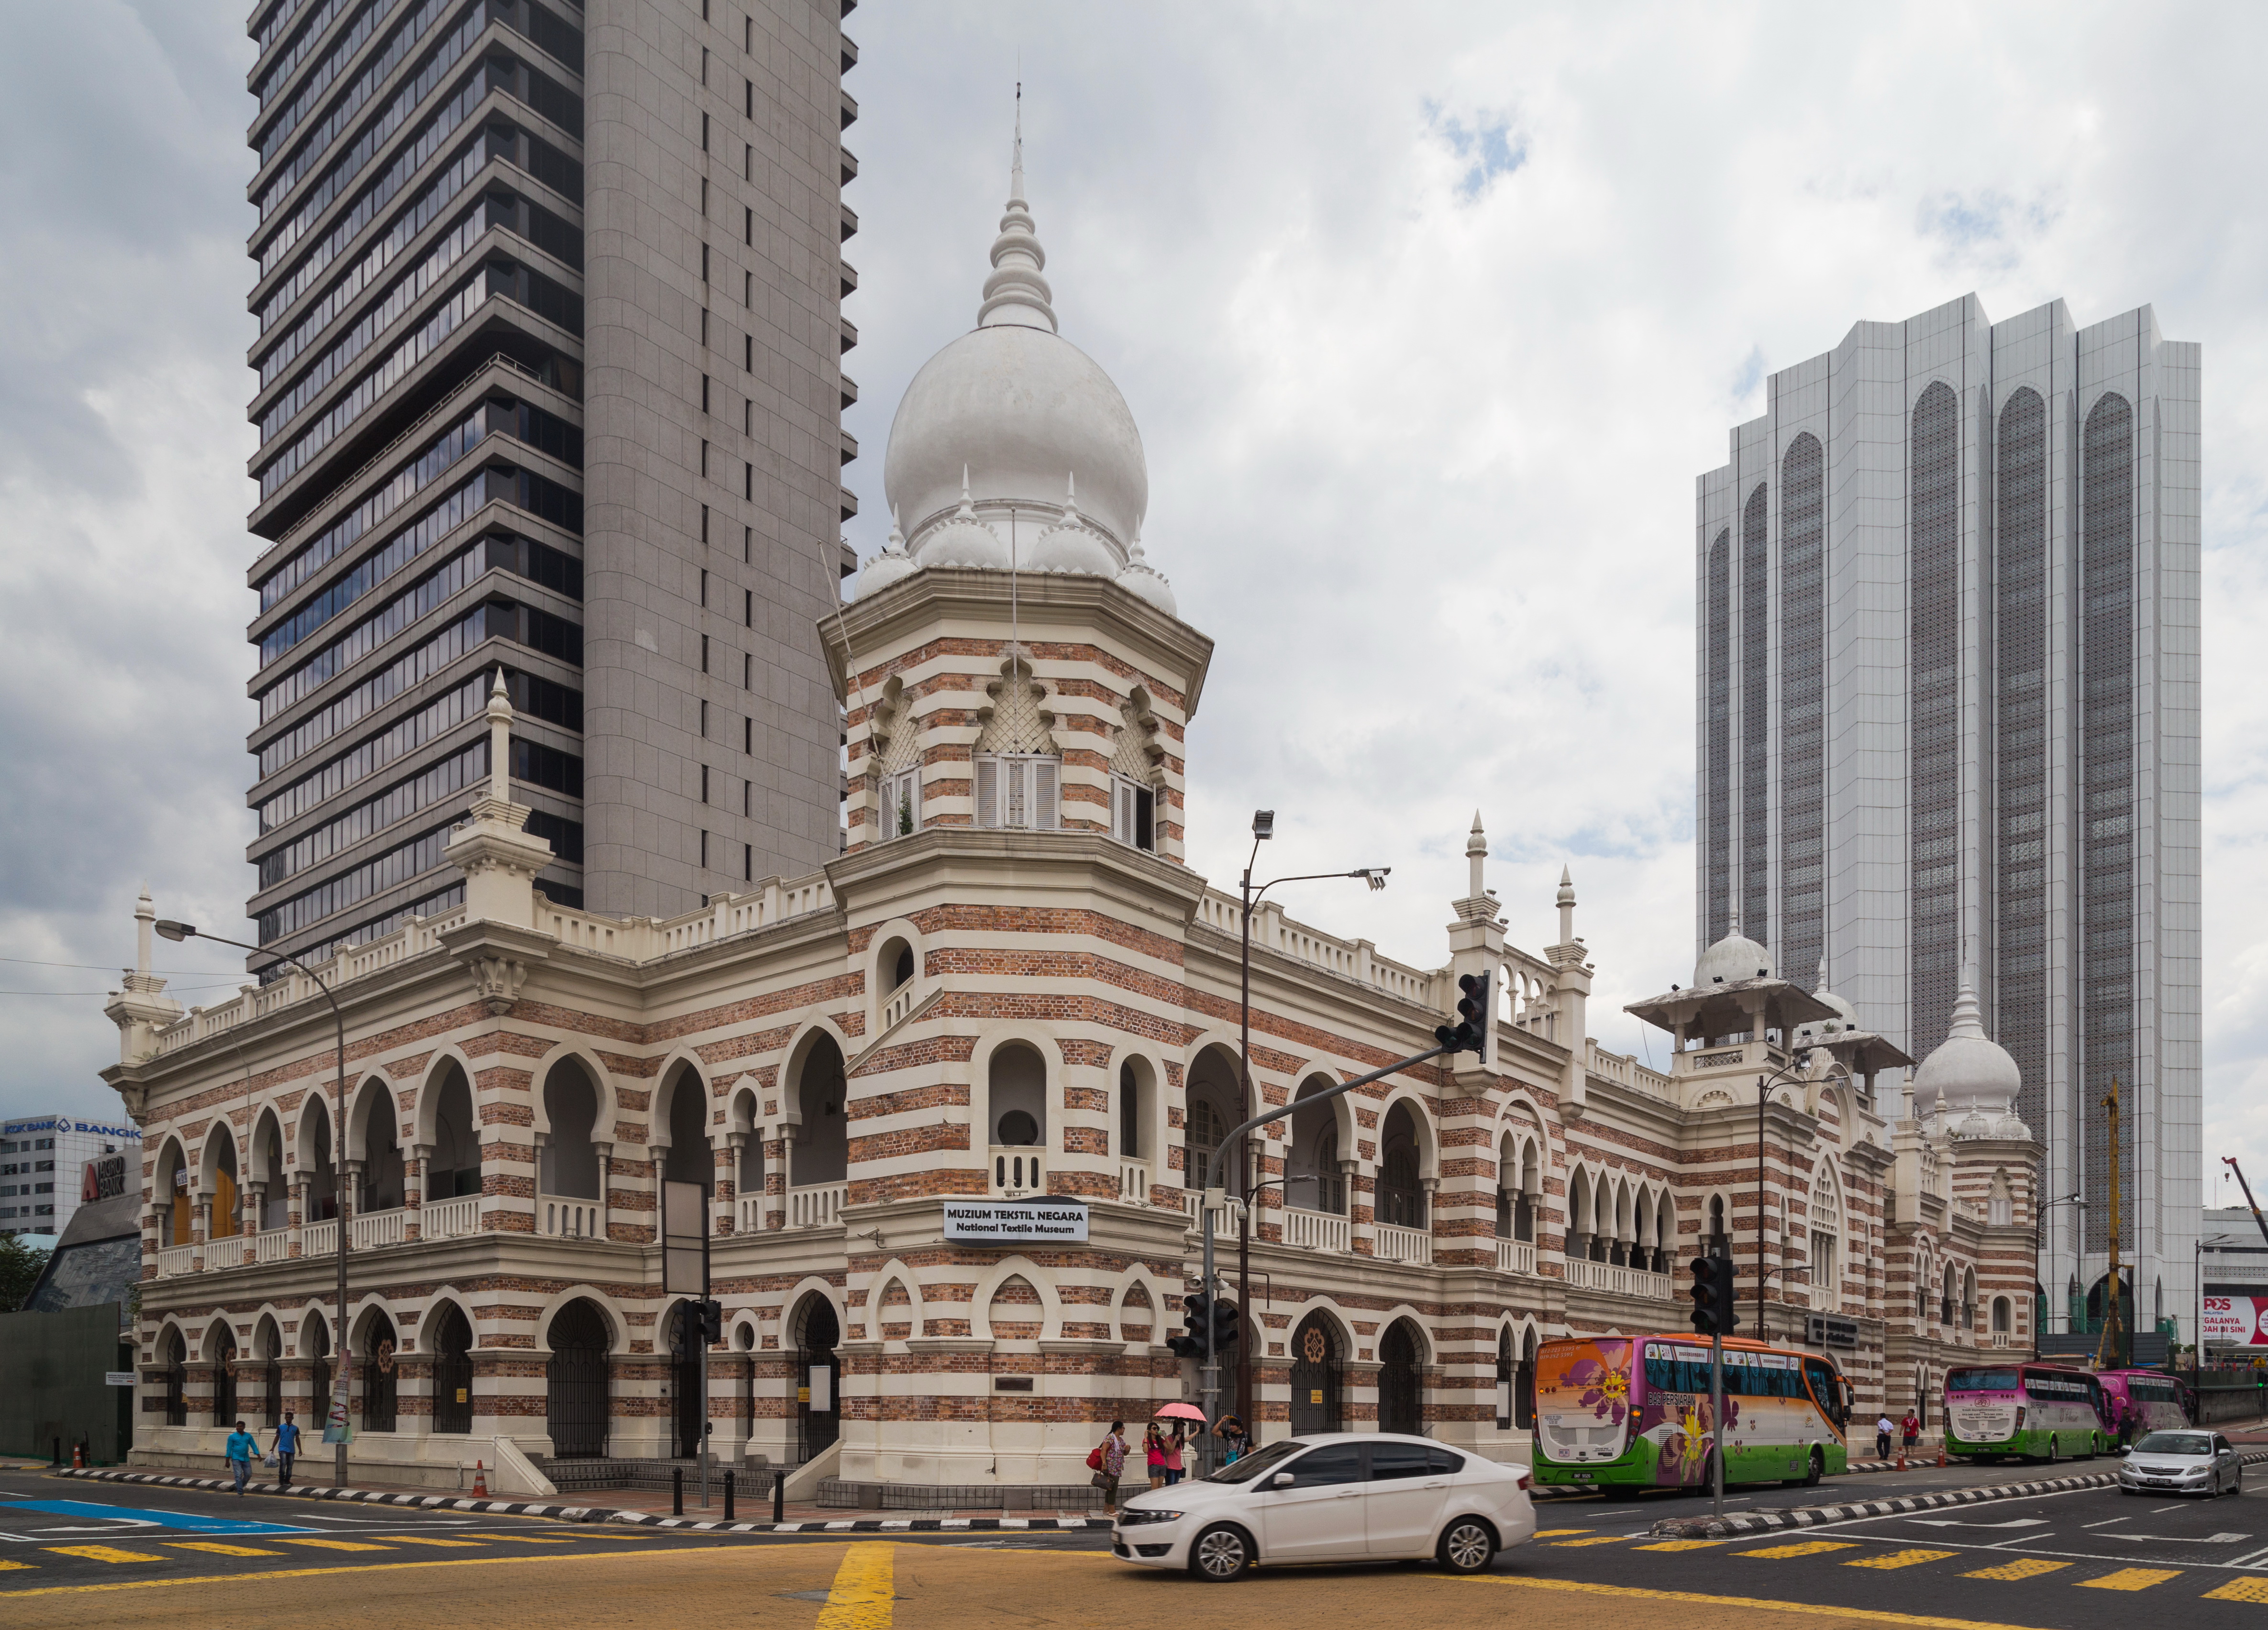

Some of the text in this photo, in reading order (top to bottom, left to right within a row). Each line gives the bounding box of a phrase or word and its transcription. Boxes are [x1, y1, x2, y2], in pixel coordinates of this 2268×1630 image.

[27, 1121, 56, 1131] BANK
[100, 1156, 124, 1178] AGRO
[100, 1175, 124, 1198] BANK
[948, 1210, 1083, 1221] MUZIUM TEKSTIL NEGARA
[956, 1223, 1074, 1234] National Textile Museum
[2204, 1298, 2231, 1311] POS
[1648, 1392, 1696, 1407] BAS PERSIARAN
